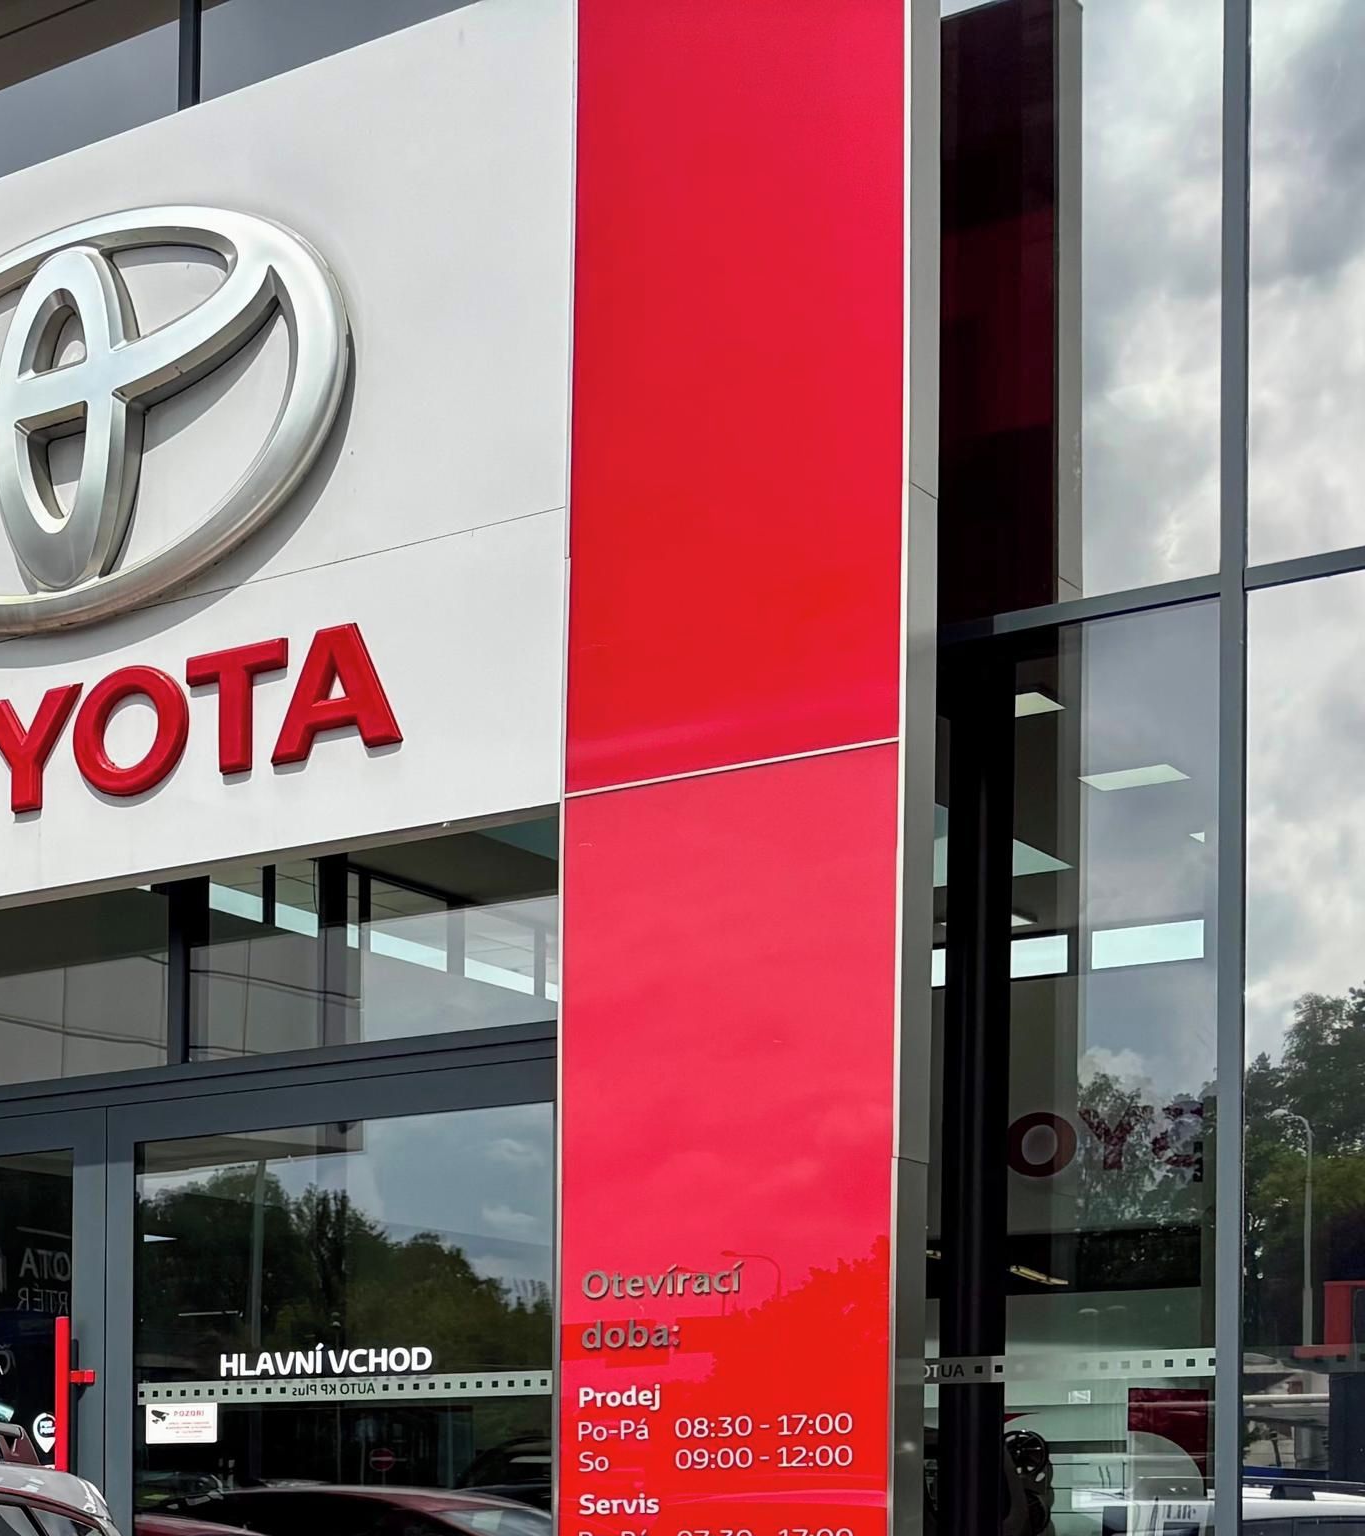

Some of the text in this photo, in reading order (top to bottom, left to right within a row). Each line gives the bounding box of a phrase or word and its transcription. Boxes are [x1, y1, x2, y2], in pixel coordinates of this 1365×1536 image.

[581, 1261, 745, 1299] Otevírací
[581, 1320, 681, 1349] doba:
[220, 1343, 433, 1377] HLAVNÍ VCHOD
[578, 1383, 662, 1411] Prodej
[577, 1418, 649, 1442] Po-Pá
[674, 1415, 753, 1439] 08:30
[776, 1413, 854, 1436] 17:00
[578, 1451, 609, 1472] So
[674, 1448, 753, 1470] 09:00
[776, 1445, 854, 1468] 12:00
[578, 1493, 660, 1515] Servis
